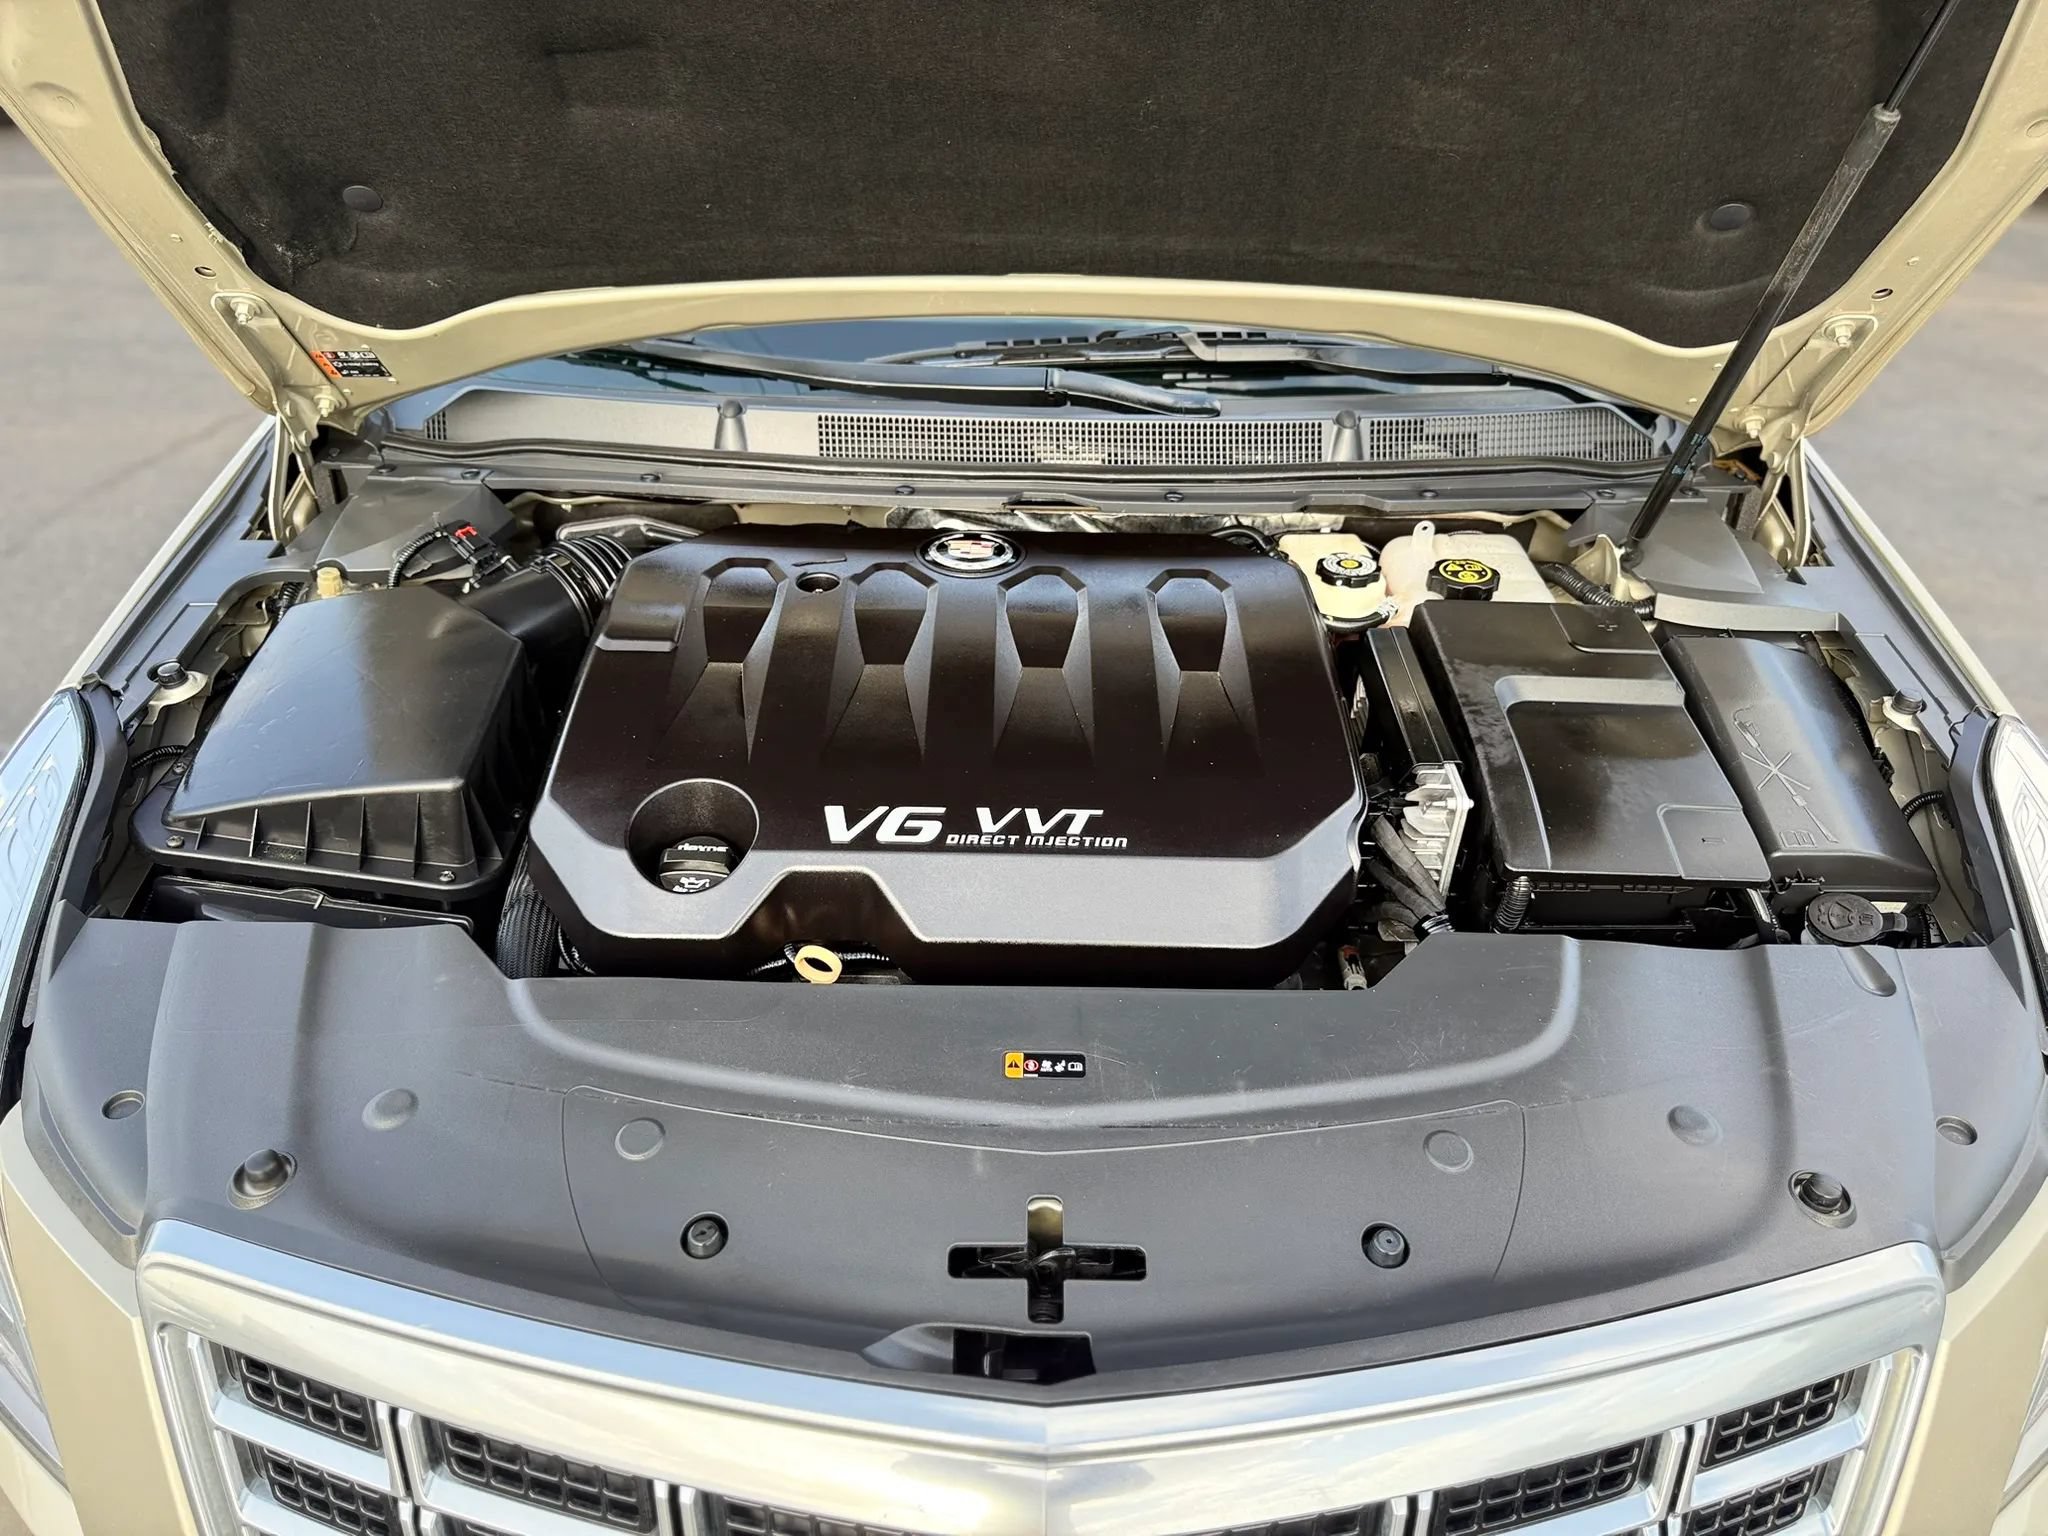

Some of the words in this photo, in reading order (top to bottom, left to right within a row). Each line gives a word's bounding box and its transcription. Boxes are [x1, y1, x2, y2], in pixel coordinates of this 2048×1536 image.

[824, 805, 946, 844] V6
[975, 806, 1104, 834] VVT
[945, 833, 1019, 847] DIRECT
[1025, 834, 1128, 848] INJECTION
